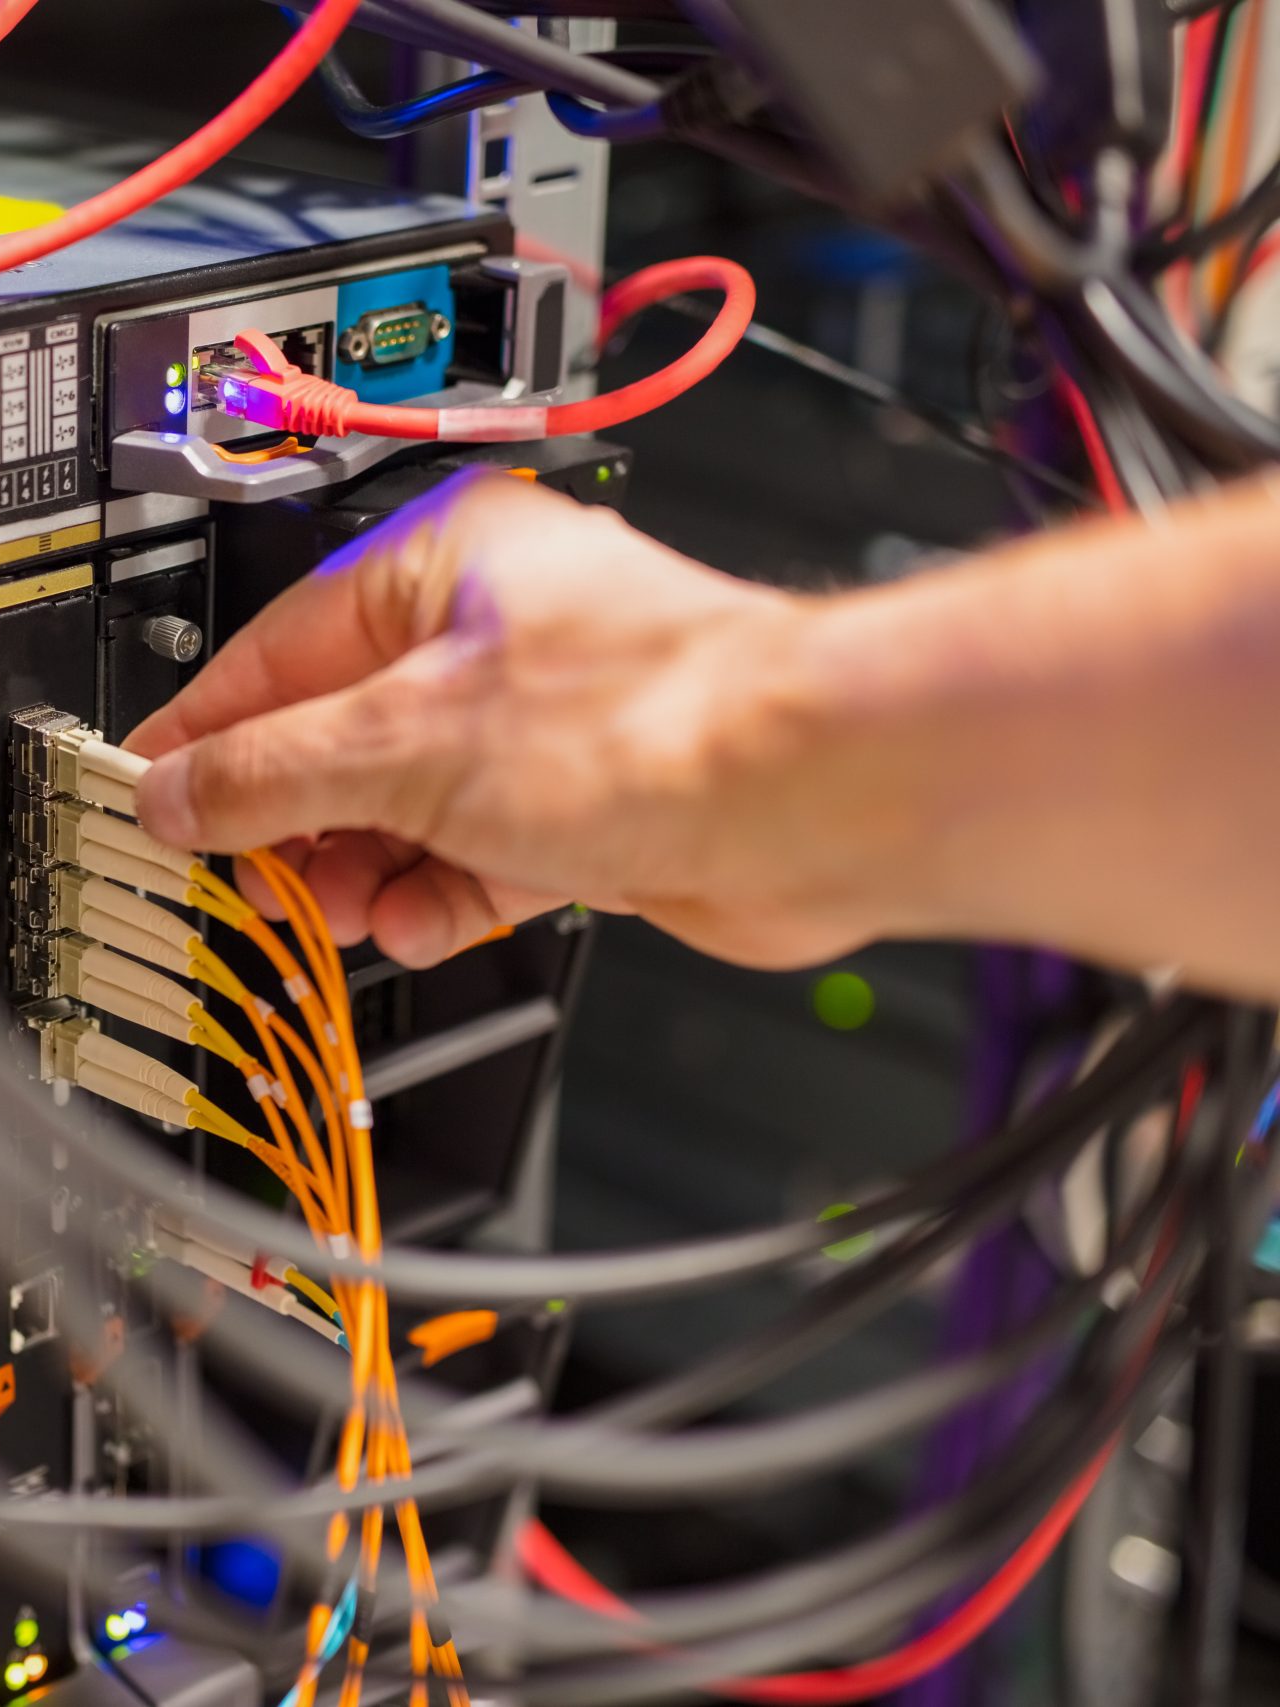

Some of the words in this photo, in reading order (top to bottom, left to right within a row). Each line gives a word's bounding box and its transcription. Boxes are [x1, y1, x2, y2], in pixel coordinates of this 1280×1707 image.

[69, 354, 75, 366] 3
[69, 390, 75, 401] 6
[69, 425, 75, 437] 9
[42, 482, 50, 496] 5
[63, 478, 71, 491] 6
[0, 491, 9, 506] 3
[21, 487, 30, 500] 4
